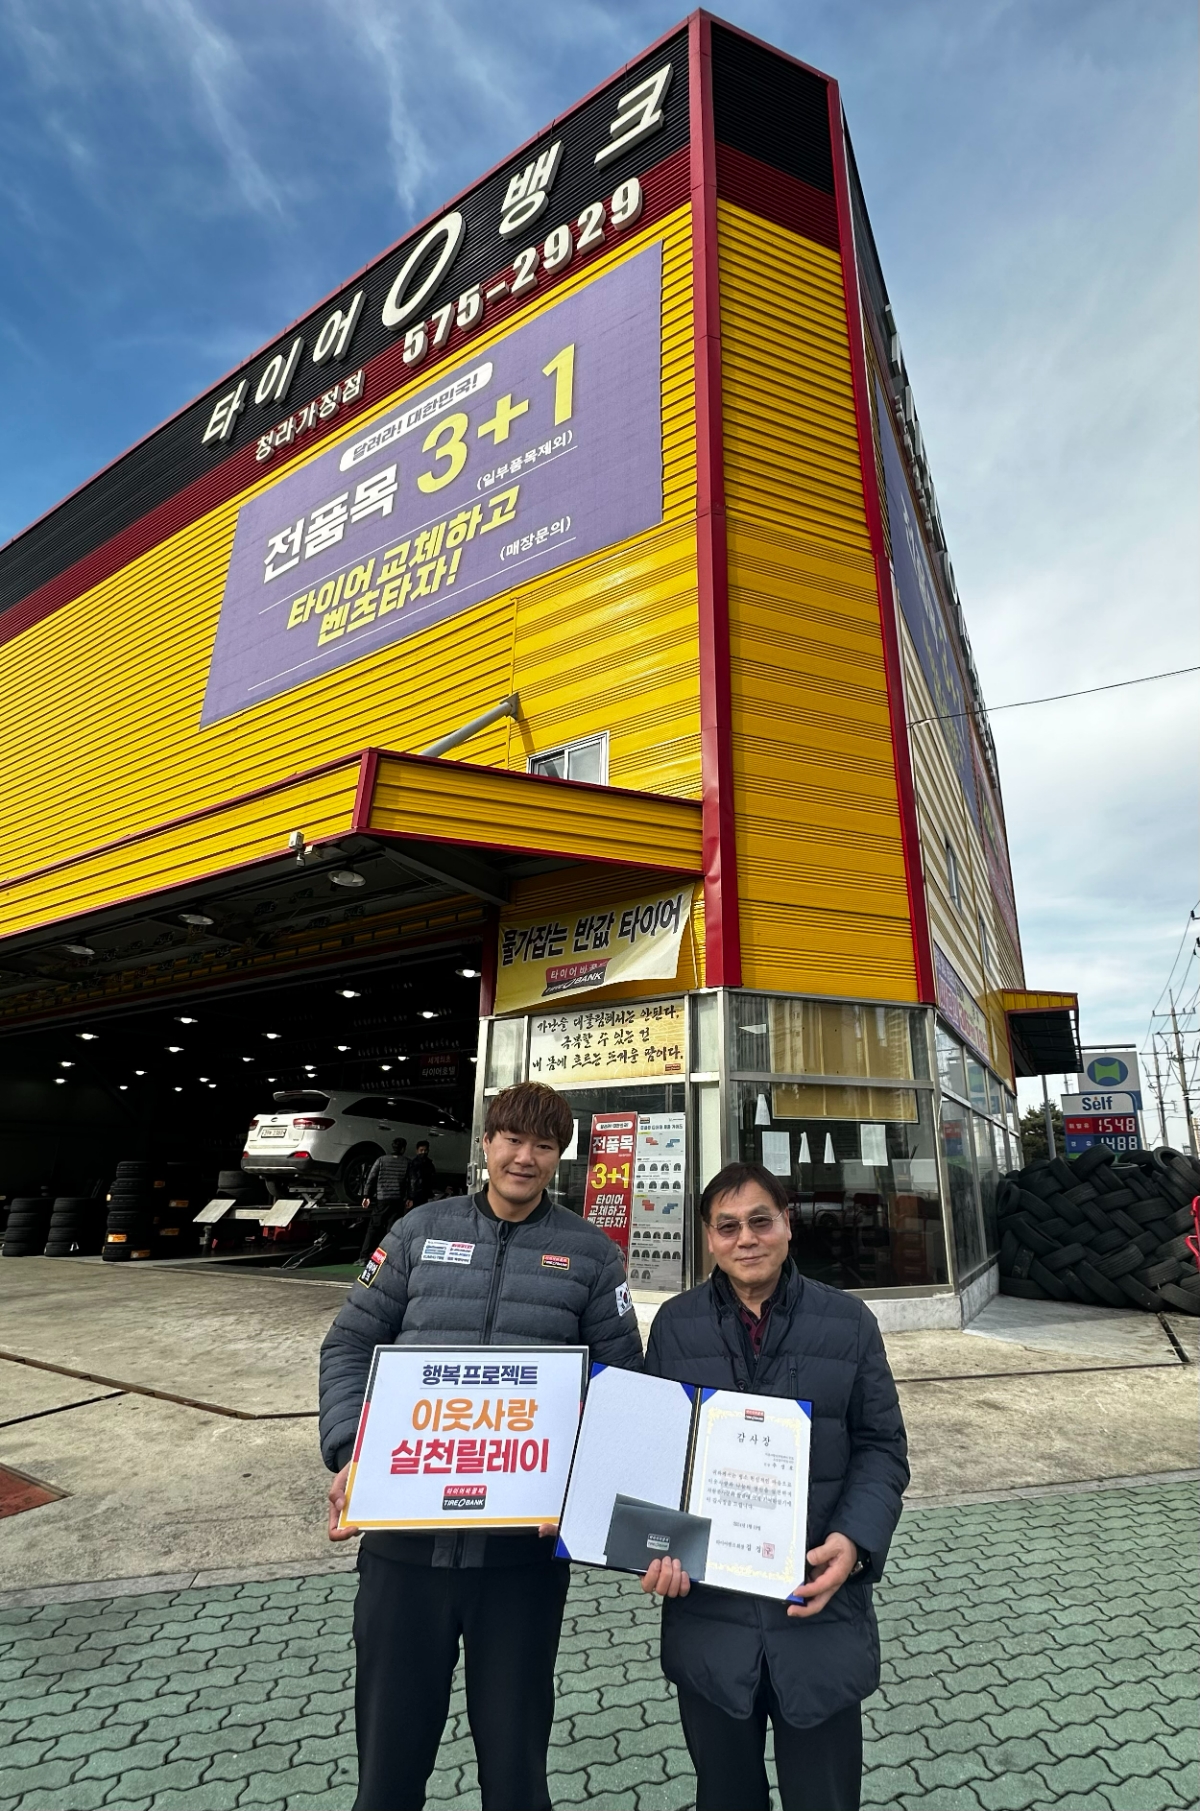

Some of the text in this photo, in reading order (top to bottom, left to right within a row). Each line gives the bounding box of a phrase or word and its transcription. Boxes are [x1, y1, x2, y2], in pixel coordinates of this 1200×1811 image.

[402, 177, 643, 367] 575-2929
[352, 373, 478, 462] 달려라! 대한민국!
[416, 343, 575, 494] 3+1
[263, 463, 399, 584] 전품목
[499, 516, 571, 561] (매장문의)
[317, 550, 461, 647] 벤츠타자!
[501, 895, 683, 966] 물가잡는 반값 타이어
[537, 1016, 569, 1033] 가난을
[597, 1031, 610, 1047] 수
[613, 1028, 635, 1046] 있는
[532, 1044, 684, 1072] 내 몸에 흐르는 뜨거운 땀이다.
[1081, 1095, 1113, 1111] Self
[1098, 1118, 1135, 1132] 1548
[592, 1134, 634, 1154] 전품목
[590, 1162, 631, 1190] 3+1
[588, 1205, 627, 1216] 교체하고
[595, 1194, 624, 1205] 타이어
[411, 1398, 539, 1432] 이웃사랑
[390, 1438, 549, 1475] 실천릴레이
